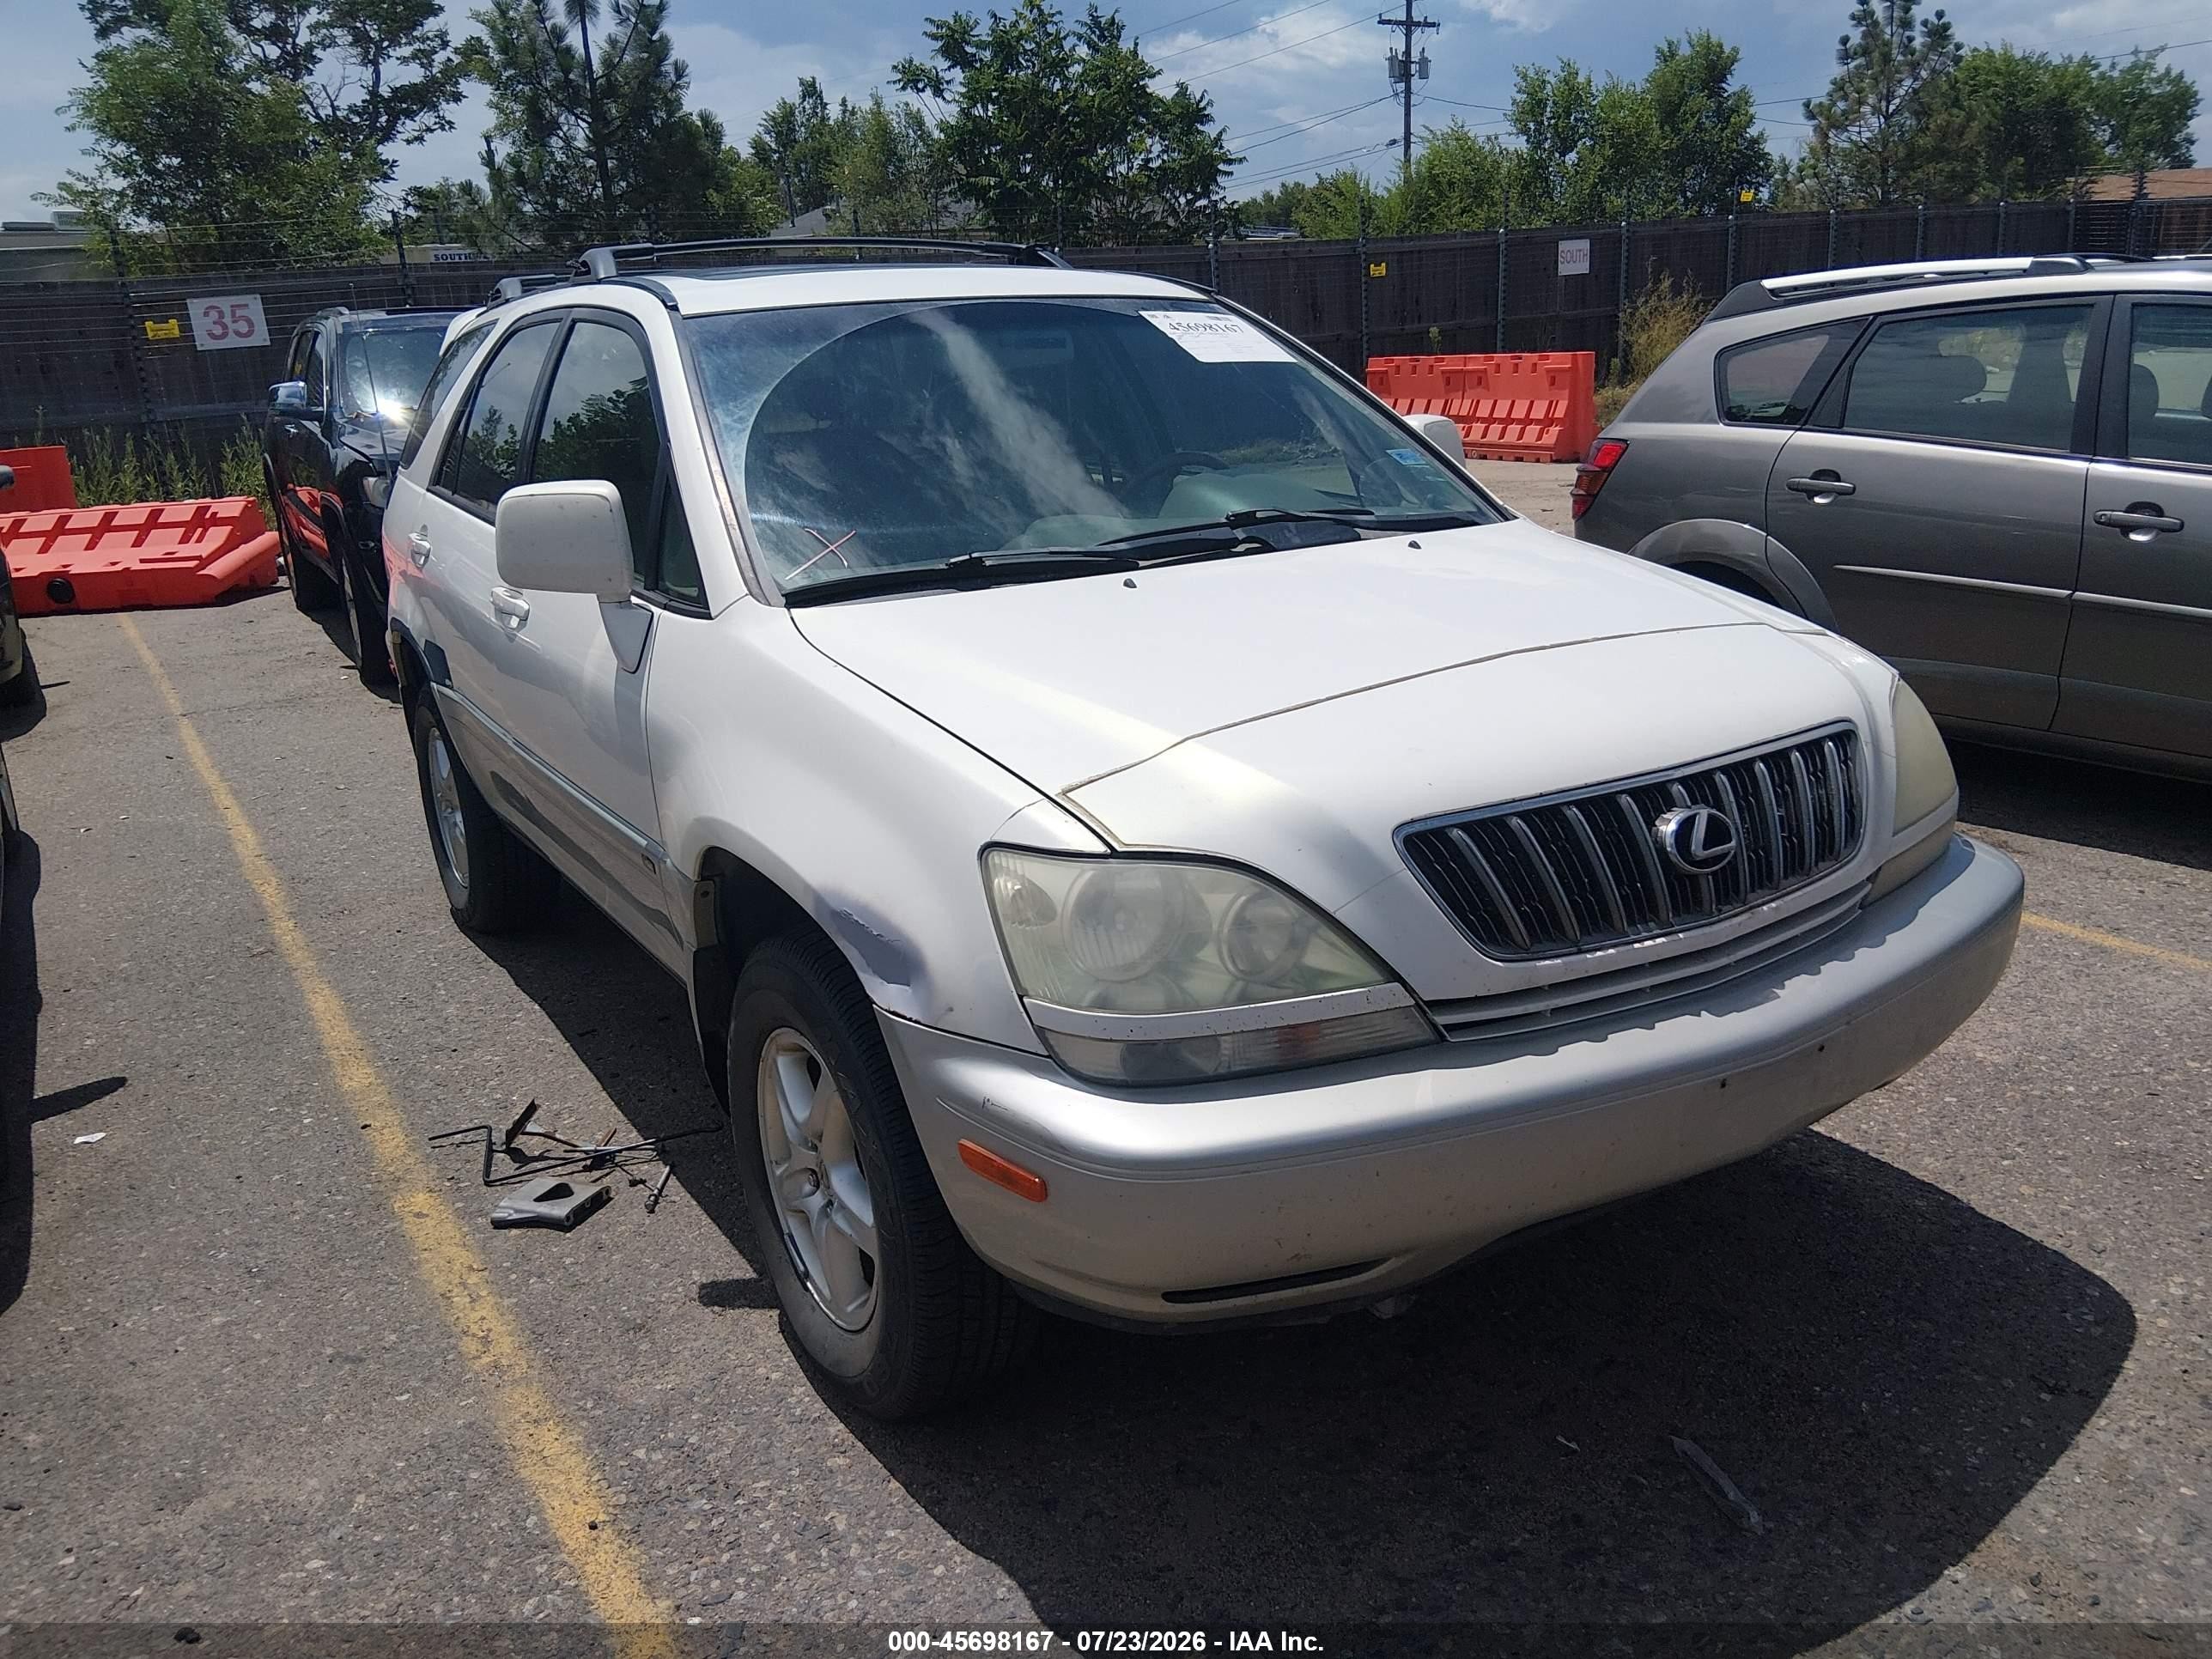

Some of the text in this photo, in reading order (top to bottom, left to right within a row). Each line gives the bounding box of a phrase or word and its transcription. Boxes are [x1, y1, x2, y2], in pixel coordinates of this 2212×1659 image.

[1559, 246, 1588, 264] SOUTH
[203, 303, 255, 341] 35
[1168, 321, 1245, 334] 45698167
